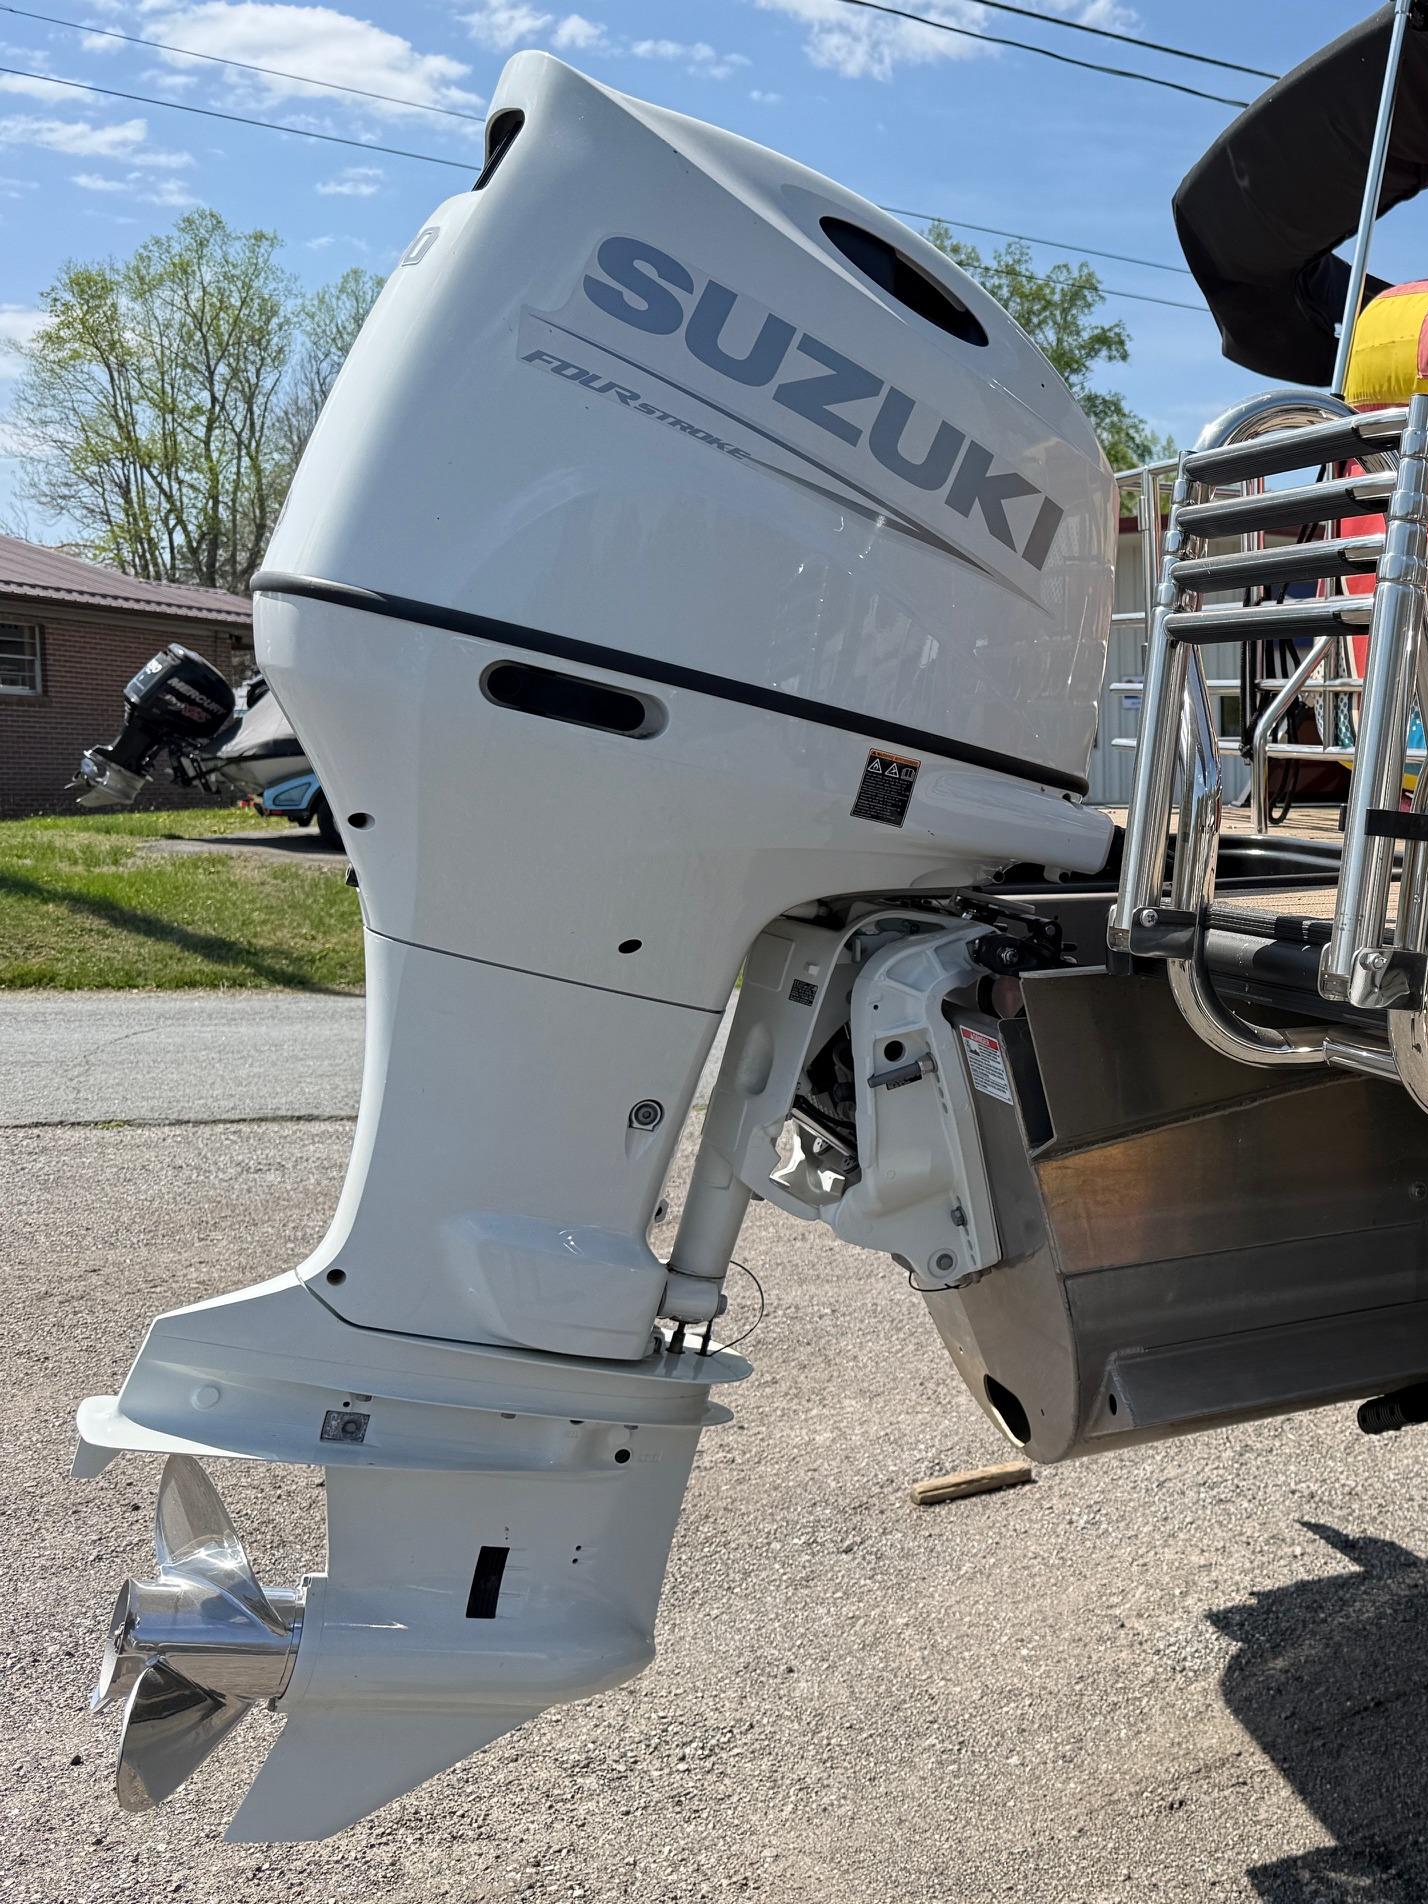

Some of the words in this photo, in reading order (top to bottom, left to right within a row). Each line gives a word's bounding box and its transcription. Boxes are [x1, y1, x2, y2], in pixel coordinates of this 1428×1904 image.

[521, 350, 641, 406] FOUR
[633, 402, 751, 460] STROKE
[583, 236, 1064, 571] SUZUKI
[167, 677, 226, 714] MERCURY
